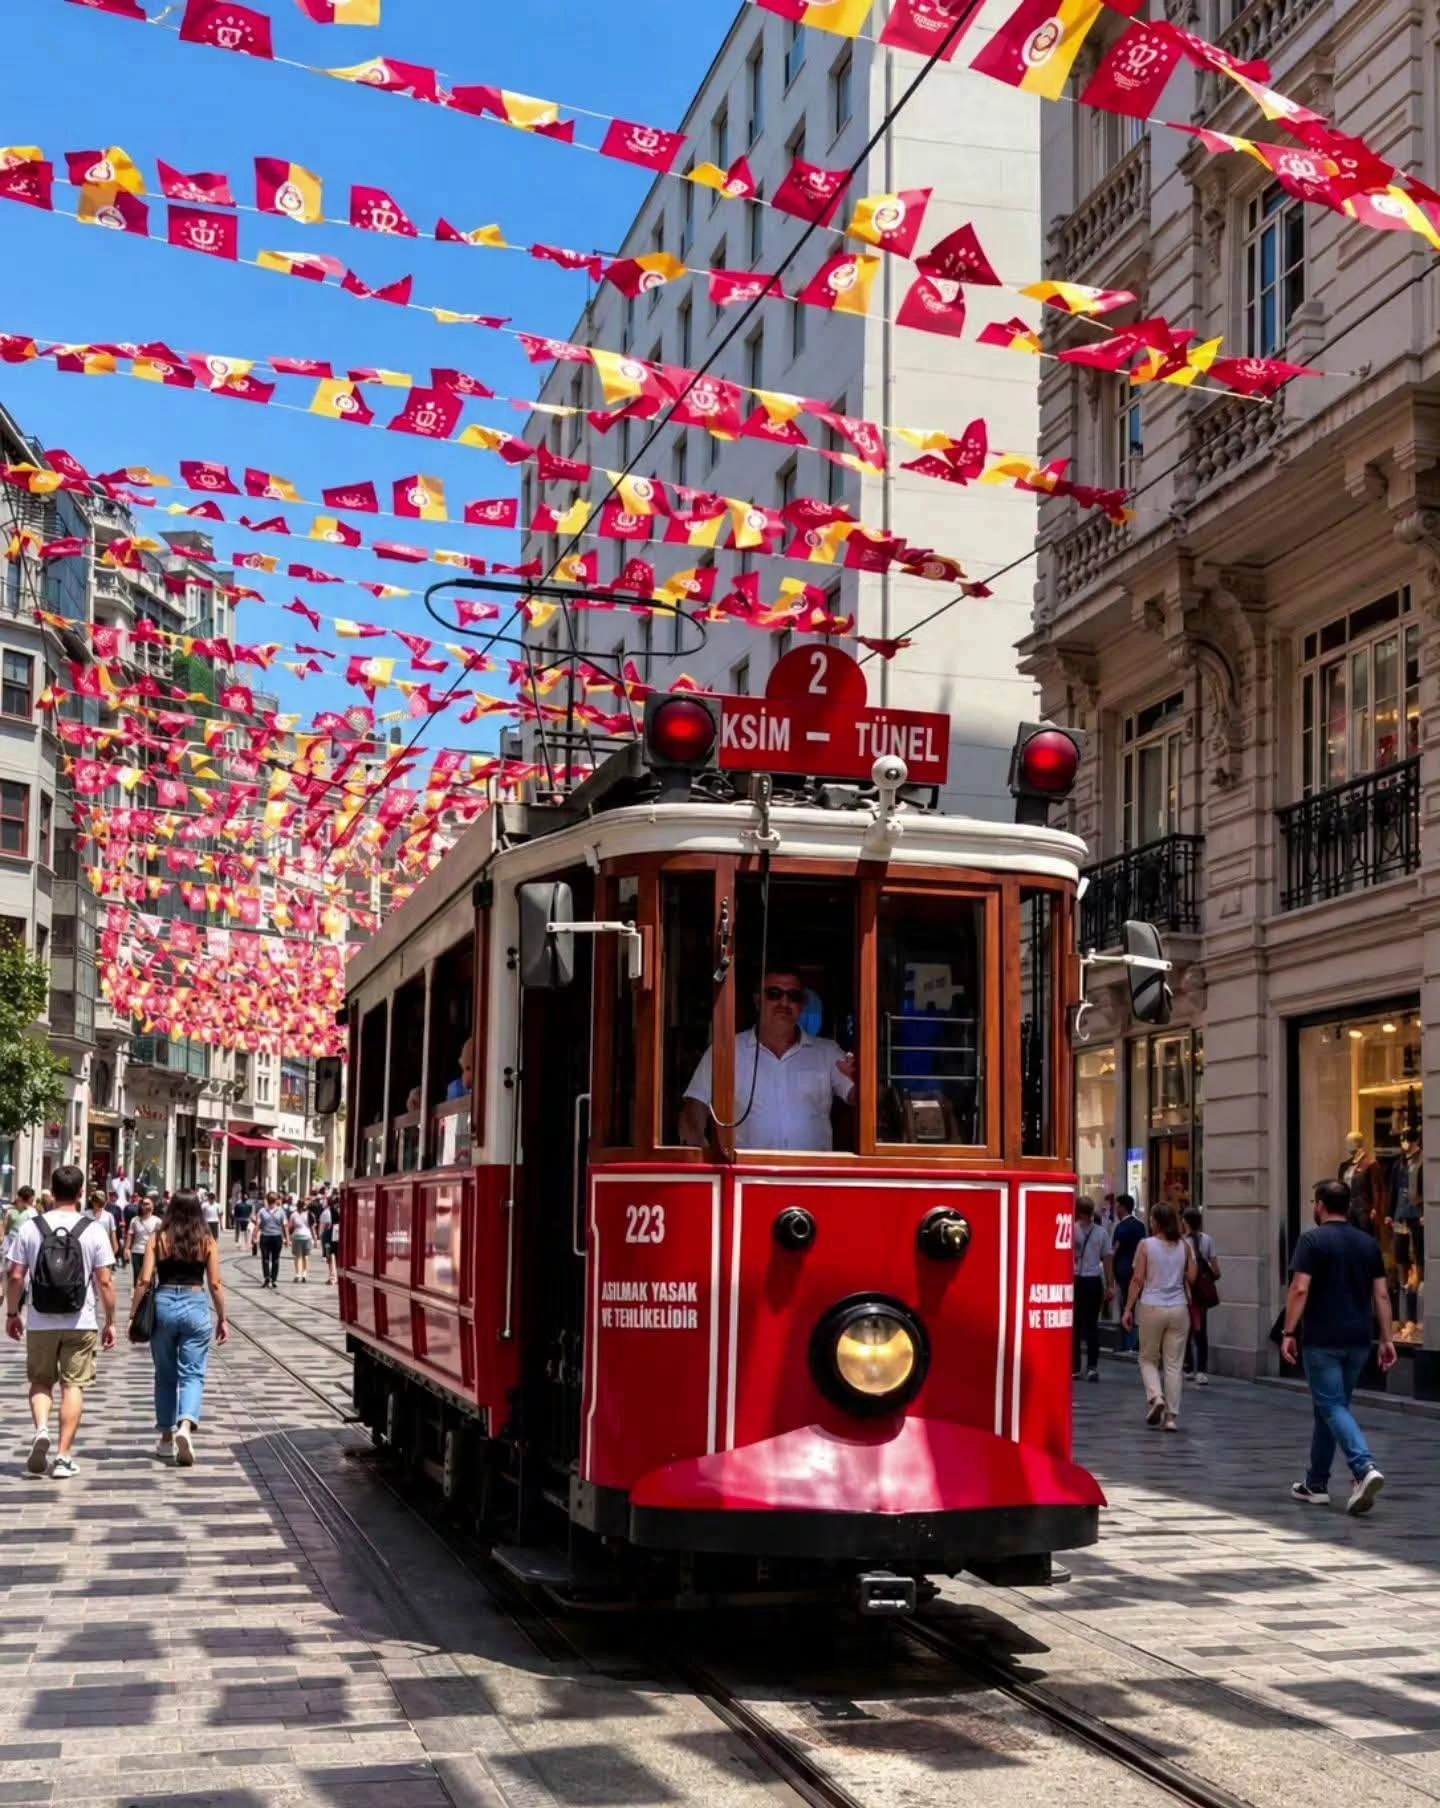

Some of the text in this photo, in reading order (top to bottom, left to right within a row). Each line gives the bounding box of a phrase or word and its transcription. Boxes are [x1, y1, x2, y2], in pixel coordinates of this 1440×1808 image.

[808, 652, 828, 694] 2
[720, 707, 790, 751] KSİM
[855, 715, 939, 762] TÜNEL
[625, 1205, 665, 1243] 223
[601, 1281, 697, 1302] ASILMAK YASAK
[601, 1304, 698, 1329] VE TEHLİKELİDİR
[1028, 1309, 1041, 1328] VE
